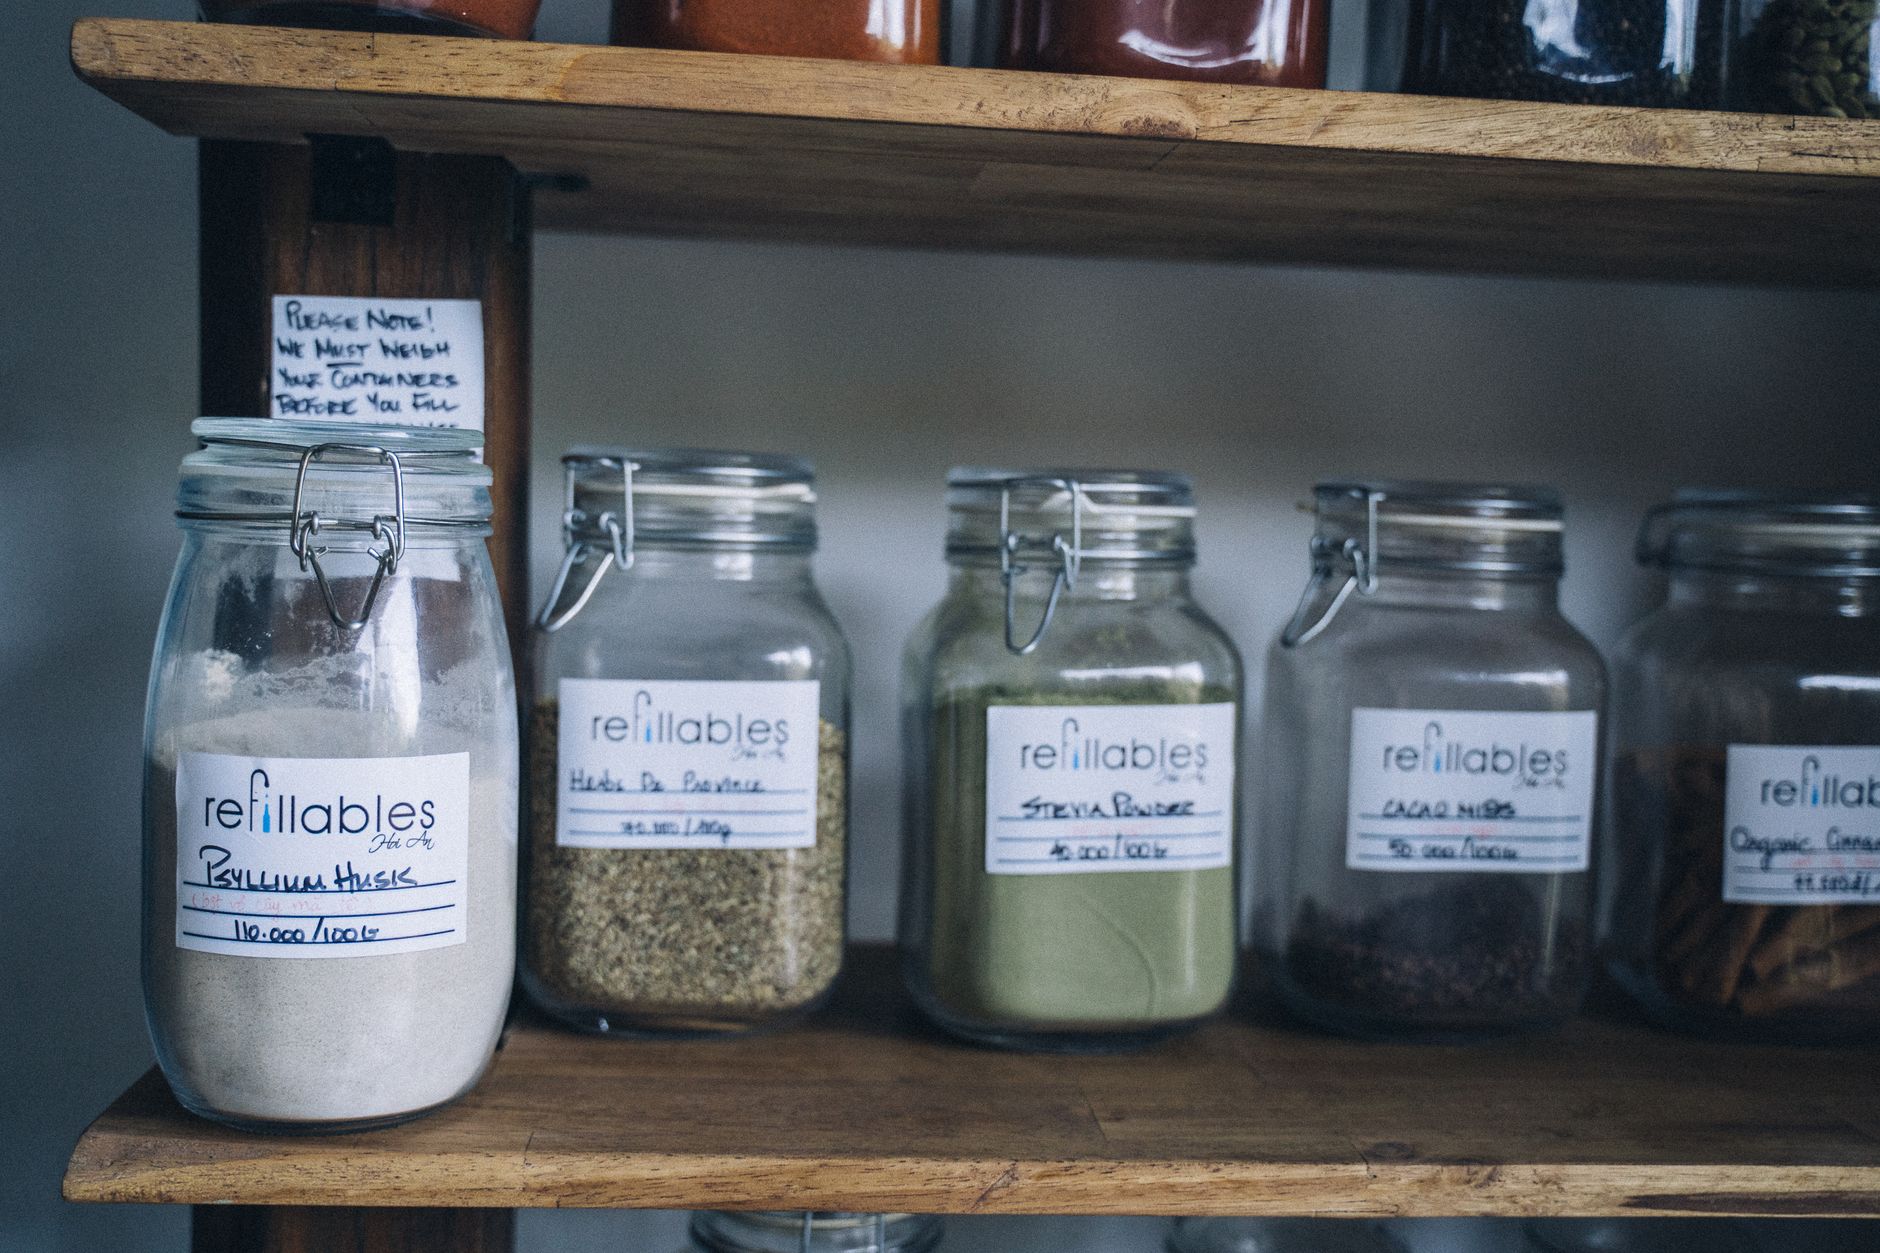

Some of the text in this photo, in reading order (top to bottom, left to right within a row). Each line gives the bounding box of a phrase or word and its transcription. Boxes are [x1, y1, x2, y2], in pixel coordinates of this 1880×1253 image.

[286, 301, 435, 333] PLEASE NOTE!
[277, 337, 450, 359] WE MUST WEIGH
[279, 367, 459, 389] YOUR CONTAINERS
[275, 392, 459, 415] BEFORE YOU FILL
[591, 690, 790, 744] refillables
[1019, 717, 1209, 771] refillables
[1382, 720, 1568, 776] refillables
[204, 768, 436, 834] refillables
